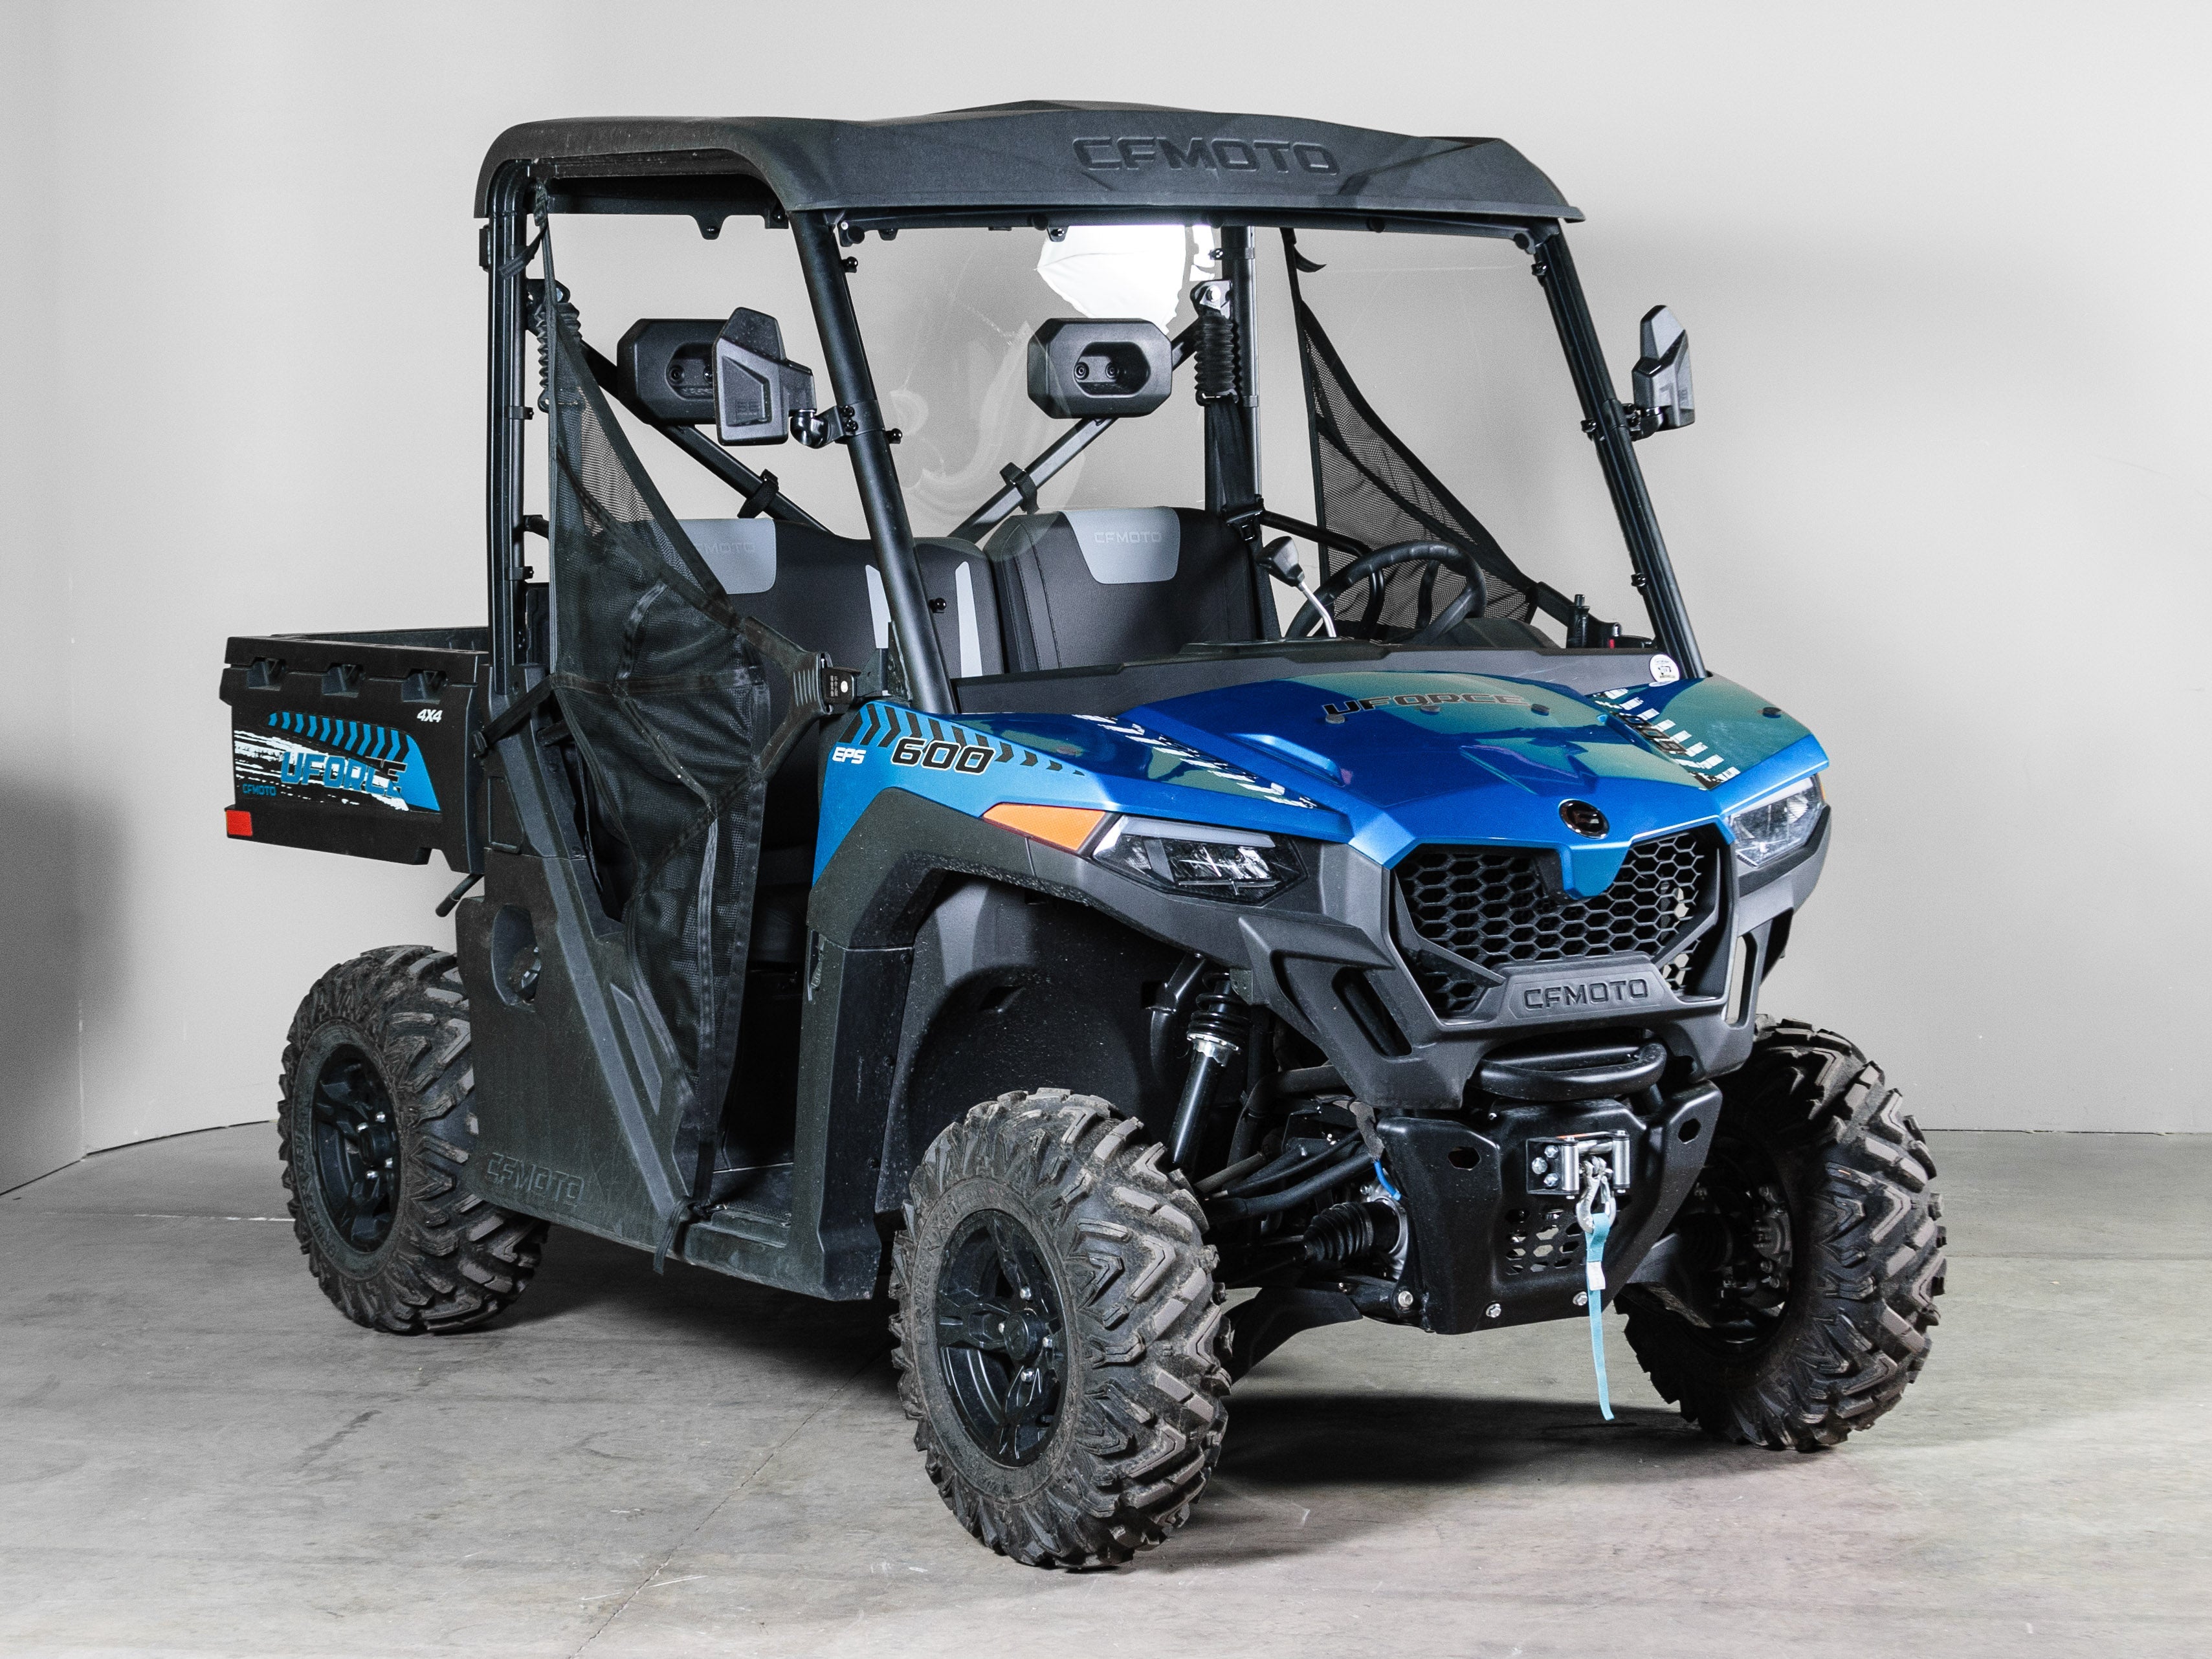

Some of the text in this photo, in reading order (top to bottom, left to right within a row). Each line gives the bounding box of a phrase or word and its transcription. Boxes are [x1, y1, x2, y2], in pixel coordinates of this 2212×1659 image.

[1072, 137, 1340, 175] CFMOTO
[1094, 531, 1162, 544] CFMOTO
[1322, 693, 1532, 716] UFORCE
[832, 747, 866, 764] EPS
[891, 737, 996, 775] 600
[242, 783, 276, 797] CFMOTO
[280, 751, 408, 798] UFORCE
[1523, 978, 1648, 1011] CFMOTO
[487, 1152, 585, 1209] CFMOTO
